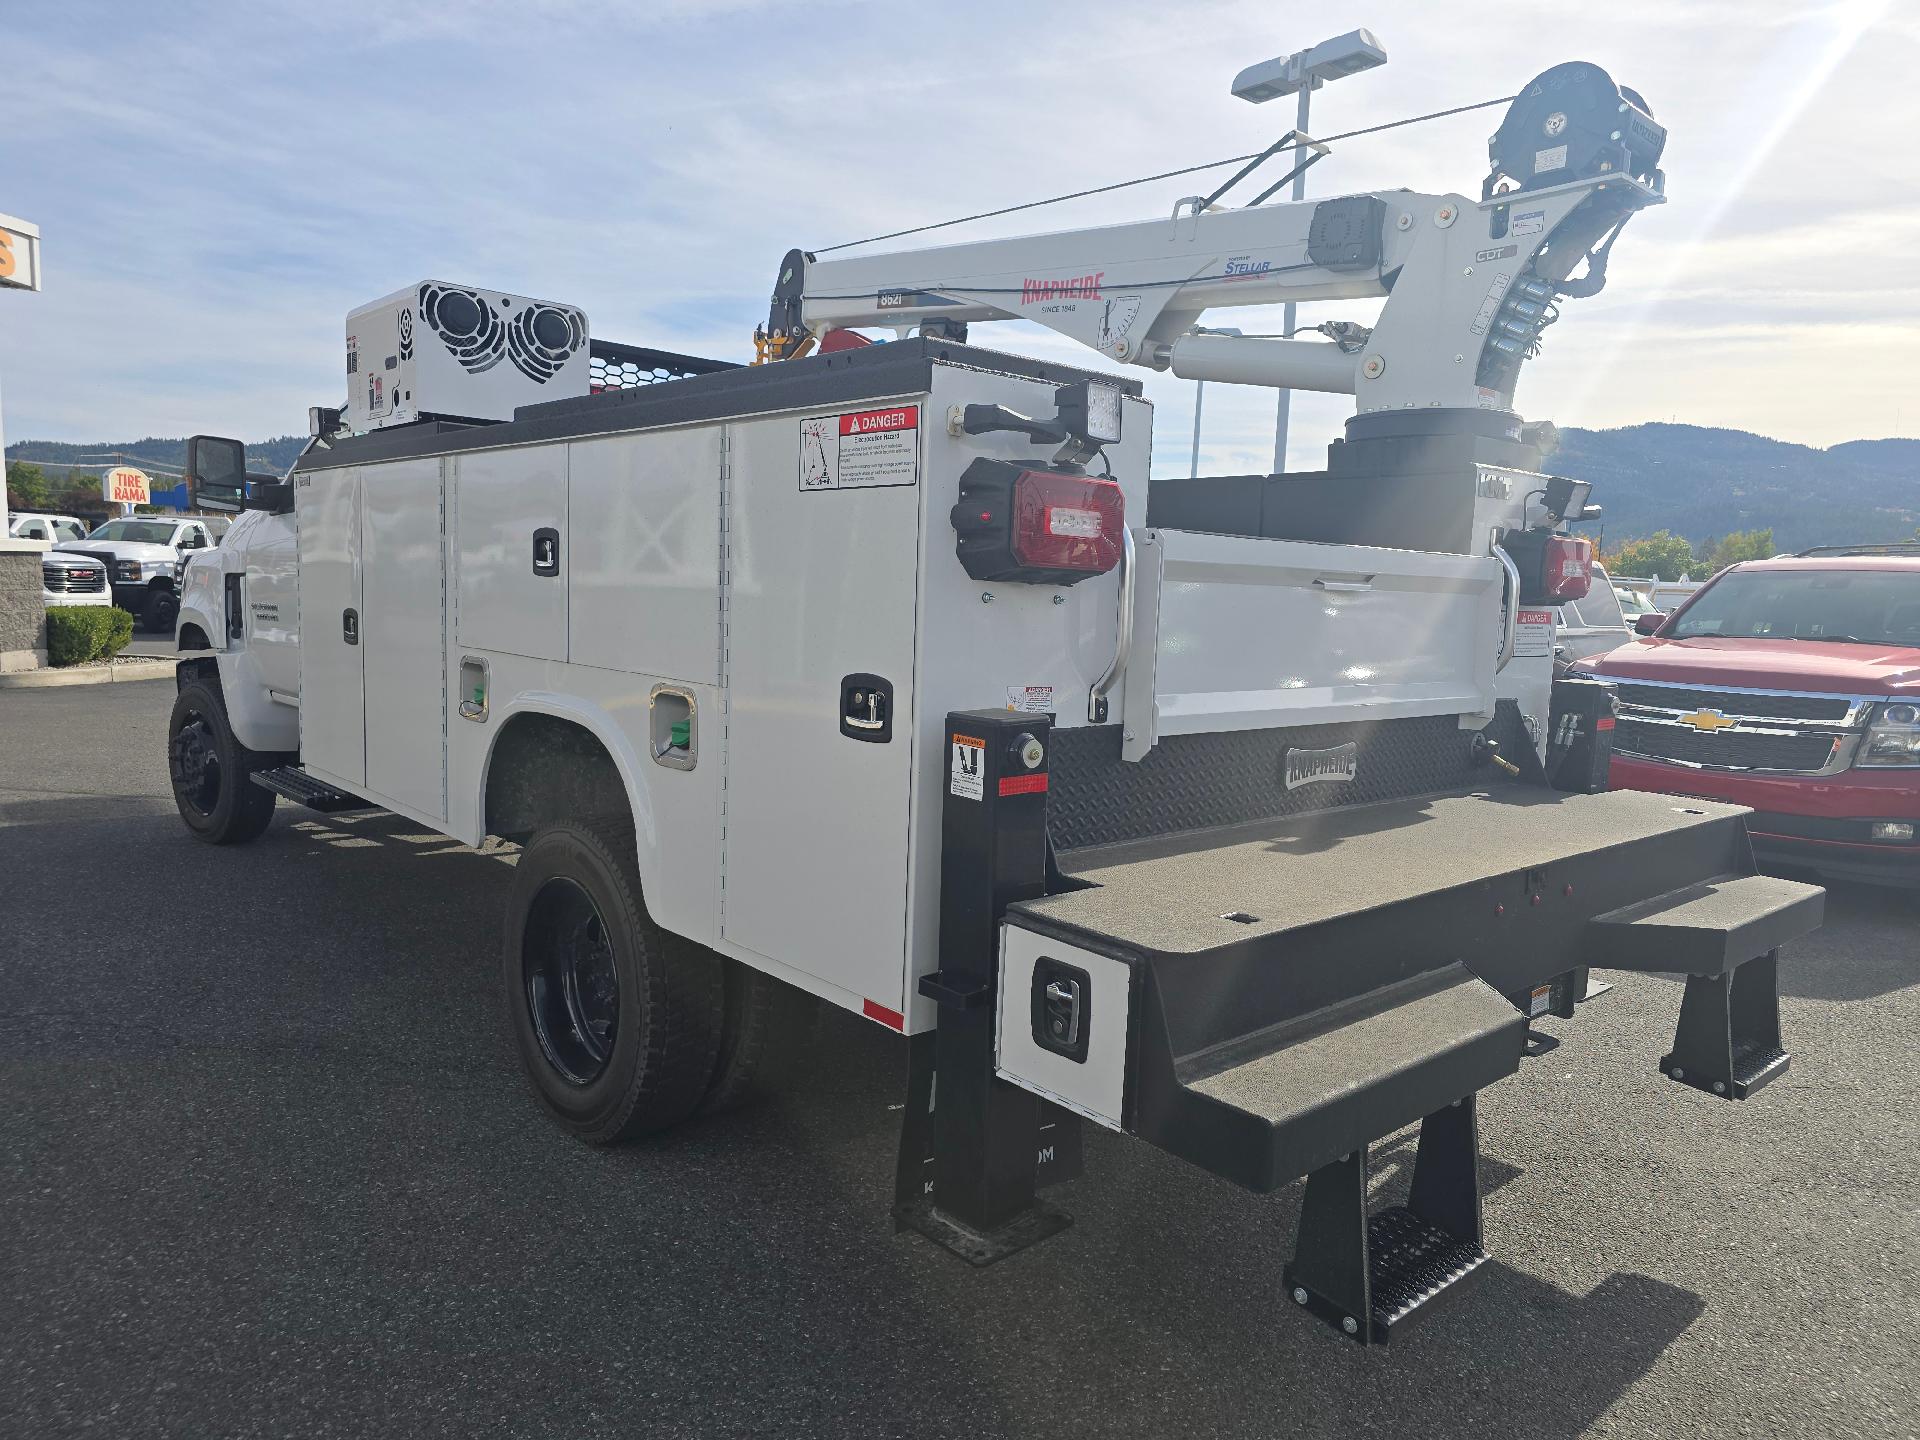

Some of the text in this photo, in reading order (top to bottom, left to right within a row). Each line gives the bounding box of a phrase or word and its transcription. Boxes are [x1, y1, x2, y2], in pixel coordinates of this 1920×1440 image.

[1225, 262, 1272, 274] STELLAR
[1021, 272, 1105, 306] KNAPHEIDE
[1041, 305, 1060, 313] SINCE
[862, 412, 906, 430] DANGER
[117, 473, 142, 488] TIRE
[114, 487, 147, 502] RAMA
